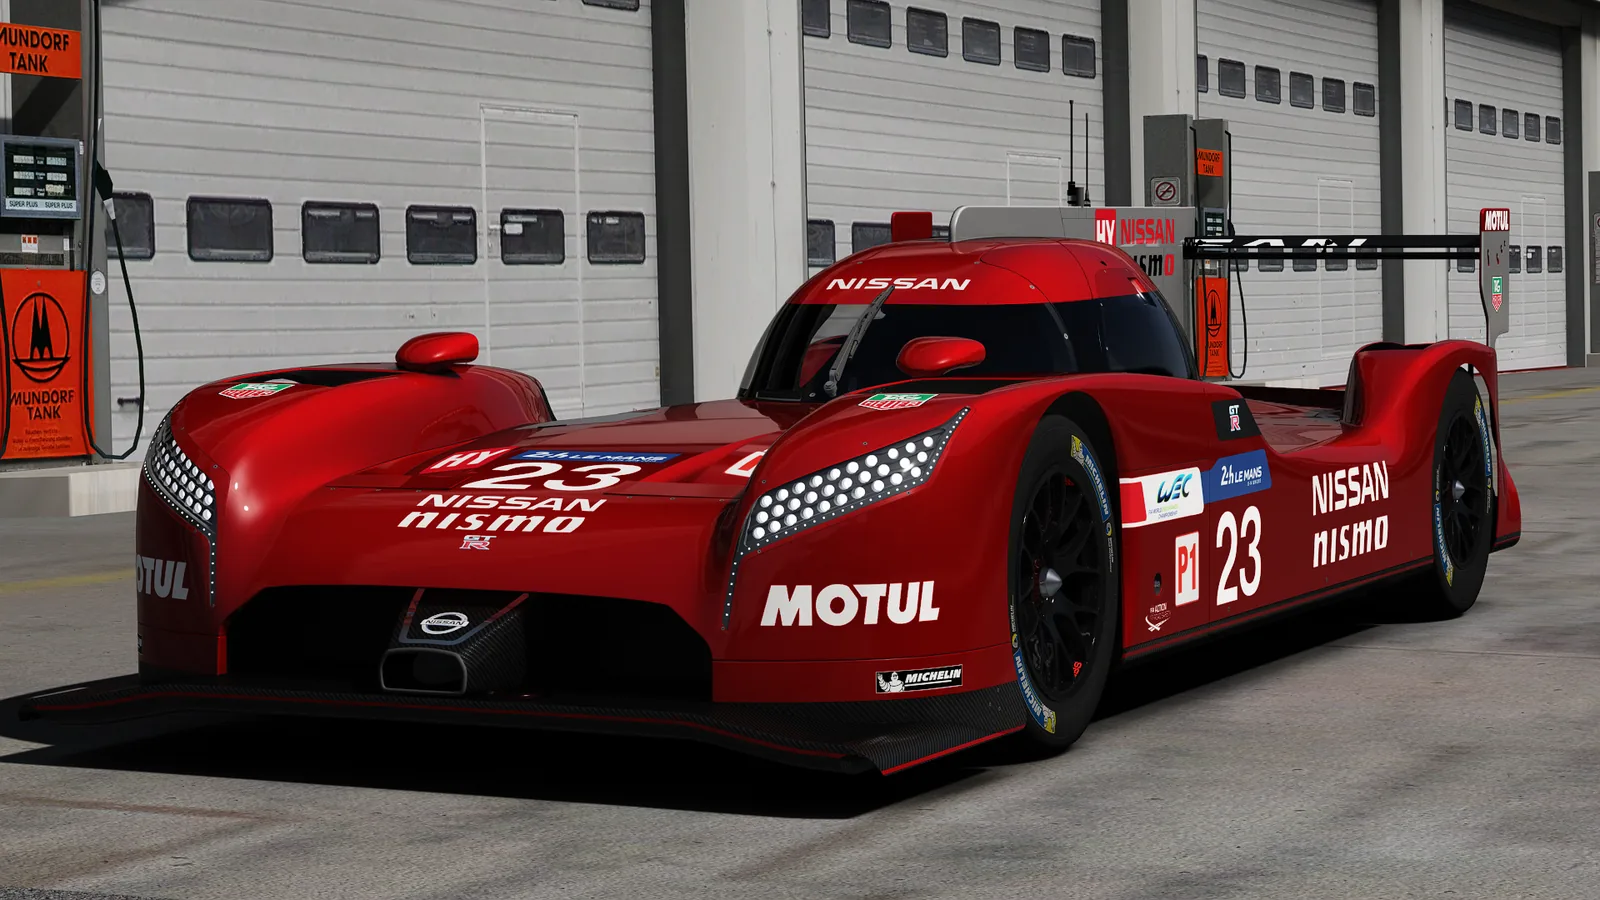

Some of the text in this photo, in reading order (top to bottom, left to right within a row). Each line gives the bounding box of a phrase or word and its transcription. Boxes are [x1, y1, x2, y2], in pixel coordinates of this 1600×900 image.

[0, 27, 70, 51] MUNDORF
[10, 52, 49, 73] TANK
[1096, 220, 1115, 245] HY
[1121, 219, 1174, 244] NISSAN
[1485, 211, 1508, 231] MOTUL
[826, 278, 971, 290] NISSAN
[10, 390, 74, 405] MUNDORF
[27, 405, 61, 420] TANK
[1228, 405, 1240, 415] GT
[1230, 415, 1241, 432] R
[430, 448, 511, 470] HY
[460, 462, 642, 491] 23
[1085, 454, 1110, 515] MICHELIN
[1235, 470, 1243, 483] LE
[1244, 466, 1262, 482] MANS
[1157, 473, 1193, 503] WEC
[1312, 460, 1389, 516] NISSAN
[416, 493, 606, 512] NISSAN
[459, 541, 490, 550] R
[1216, 505, 1261, 606] 23
[137, 554, 189, 600] OTUL
[1178, 543, 1196, 594] P1
[760, 581, 940, 626] MOTUL
[905, 669, 961, 683] MICHELIN
[1015, 655, 1043, 717] MICHELIN
